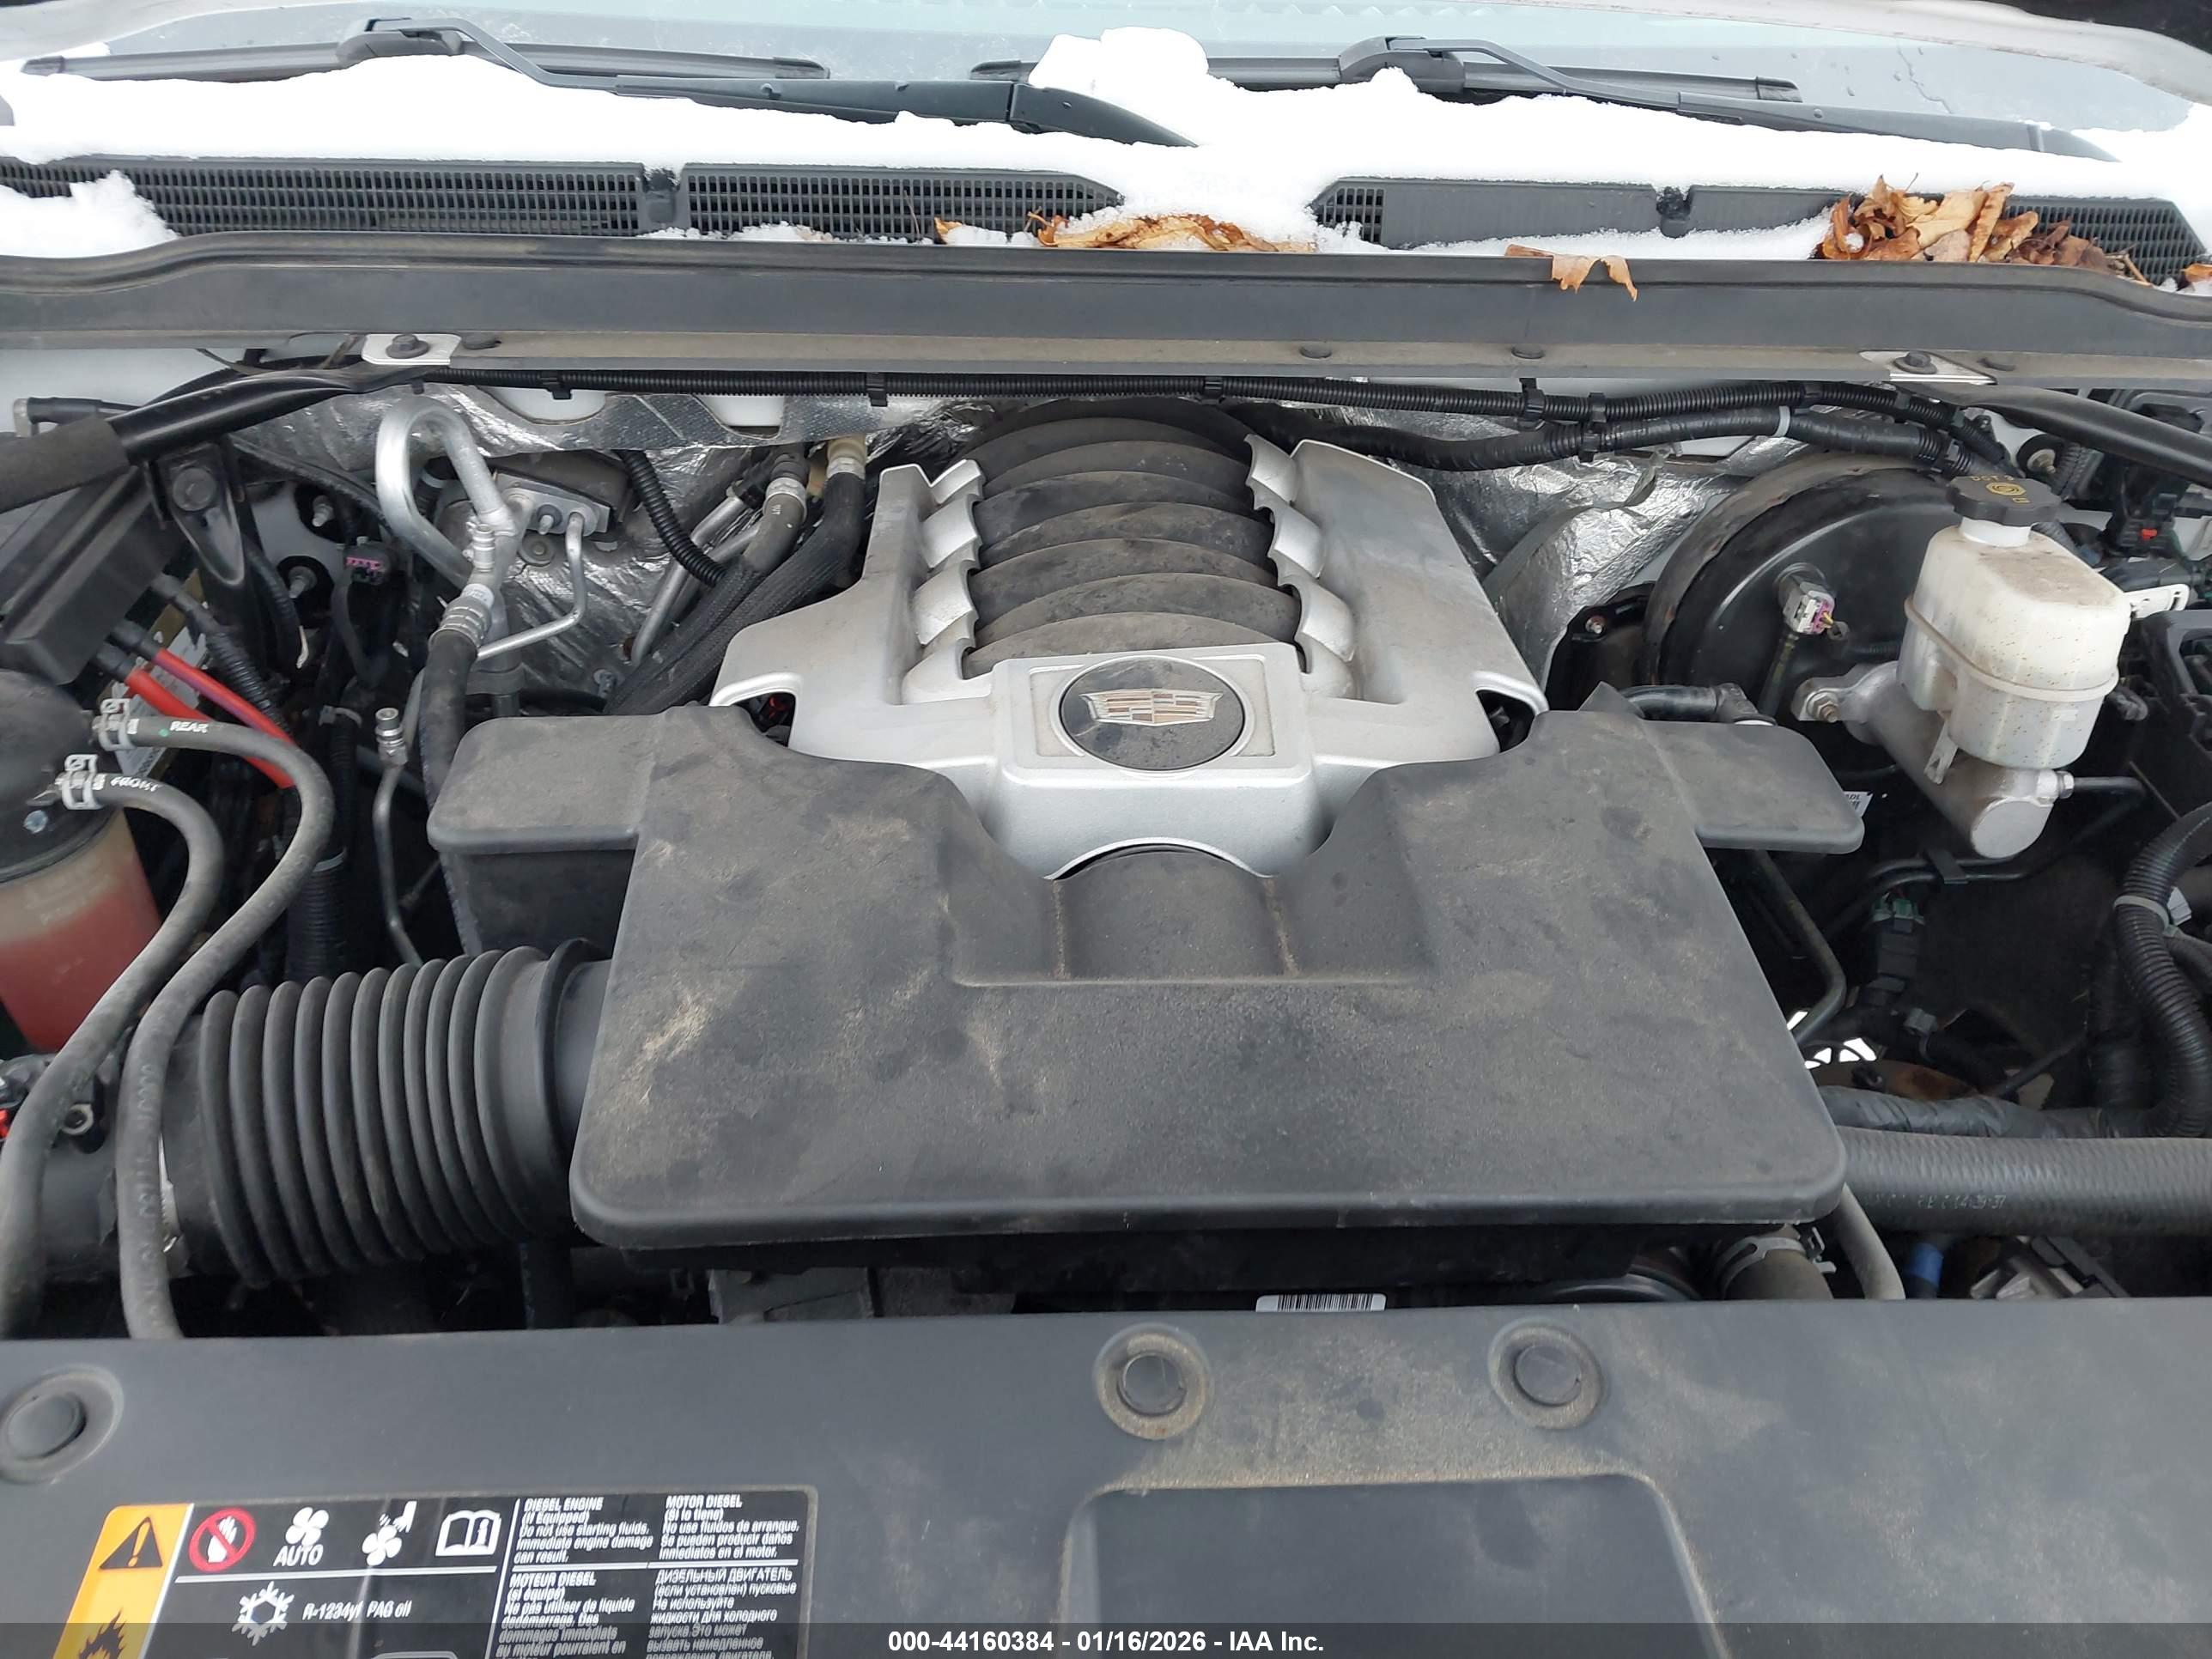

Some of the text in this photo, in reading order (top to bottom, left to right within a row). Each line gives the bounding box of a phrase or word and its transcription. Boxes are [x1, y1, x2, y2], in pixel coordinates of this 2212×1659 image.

[170, 721, 209, 733] REAR
[110, 776, 160, 792] FRONT
[524, 1497, 605, 1512] DIESEL ENGINE
[665, 1494, 743, 1509] MOTOR DIESEL
[536, 1510, 590, 1525] Equipped)
[680, 1508, 692, 1521] lo
[693, 1508, 724, 1522] tiene)
[519, 1521, 650, 1538] Do not use starting fluids.
[662, 1520, 799, 1534] No use fluidos de arranque.
[515, 1535, 653, 1551] Immediate engine damage
[660, 1532, 793, 1547] Se pueden producir daños
[272, 1544, 324, 1567] AUTO
[514, 1549, 569, 1564] can result.
[659, 1546, 777, 1560] inmediatos en el motor.
[508, 1571, 597, 1588] MOTEUR DIESEL
[654, 1567, 793, 1584] ДИЗЕЛЬНЫЙ ДВИГАТЕЛЬ
[653, 1582, 797, 1598] (если установлен) пусковые
[504, 1597, 635, 1615] Ne pas utiliser de liquide
[653, 1596, 735, 1611] Не используйте
[302, 1601, 413, 1622] R-1234yf PAG oil
[650, 1609, 778, 1625] жидкости для холодного
[577, 1613, 599, 1627] Des
[498, 1626, 618, 1644] dommages immédiats
[714, 1623, 748, 1637] может
[495, 1640, 627, 1658] au moteur pourraient en
[646, 1638, 764, 1652] вызвать немедленное
